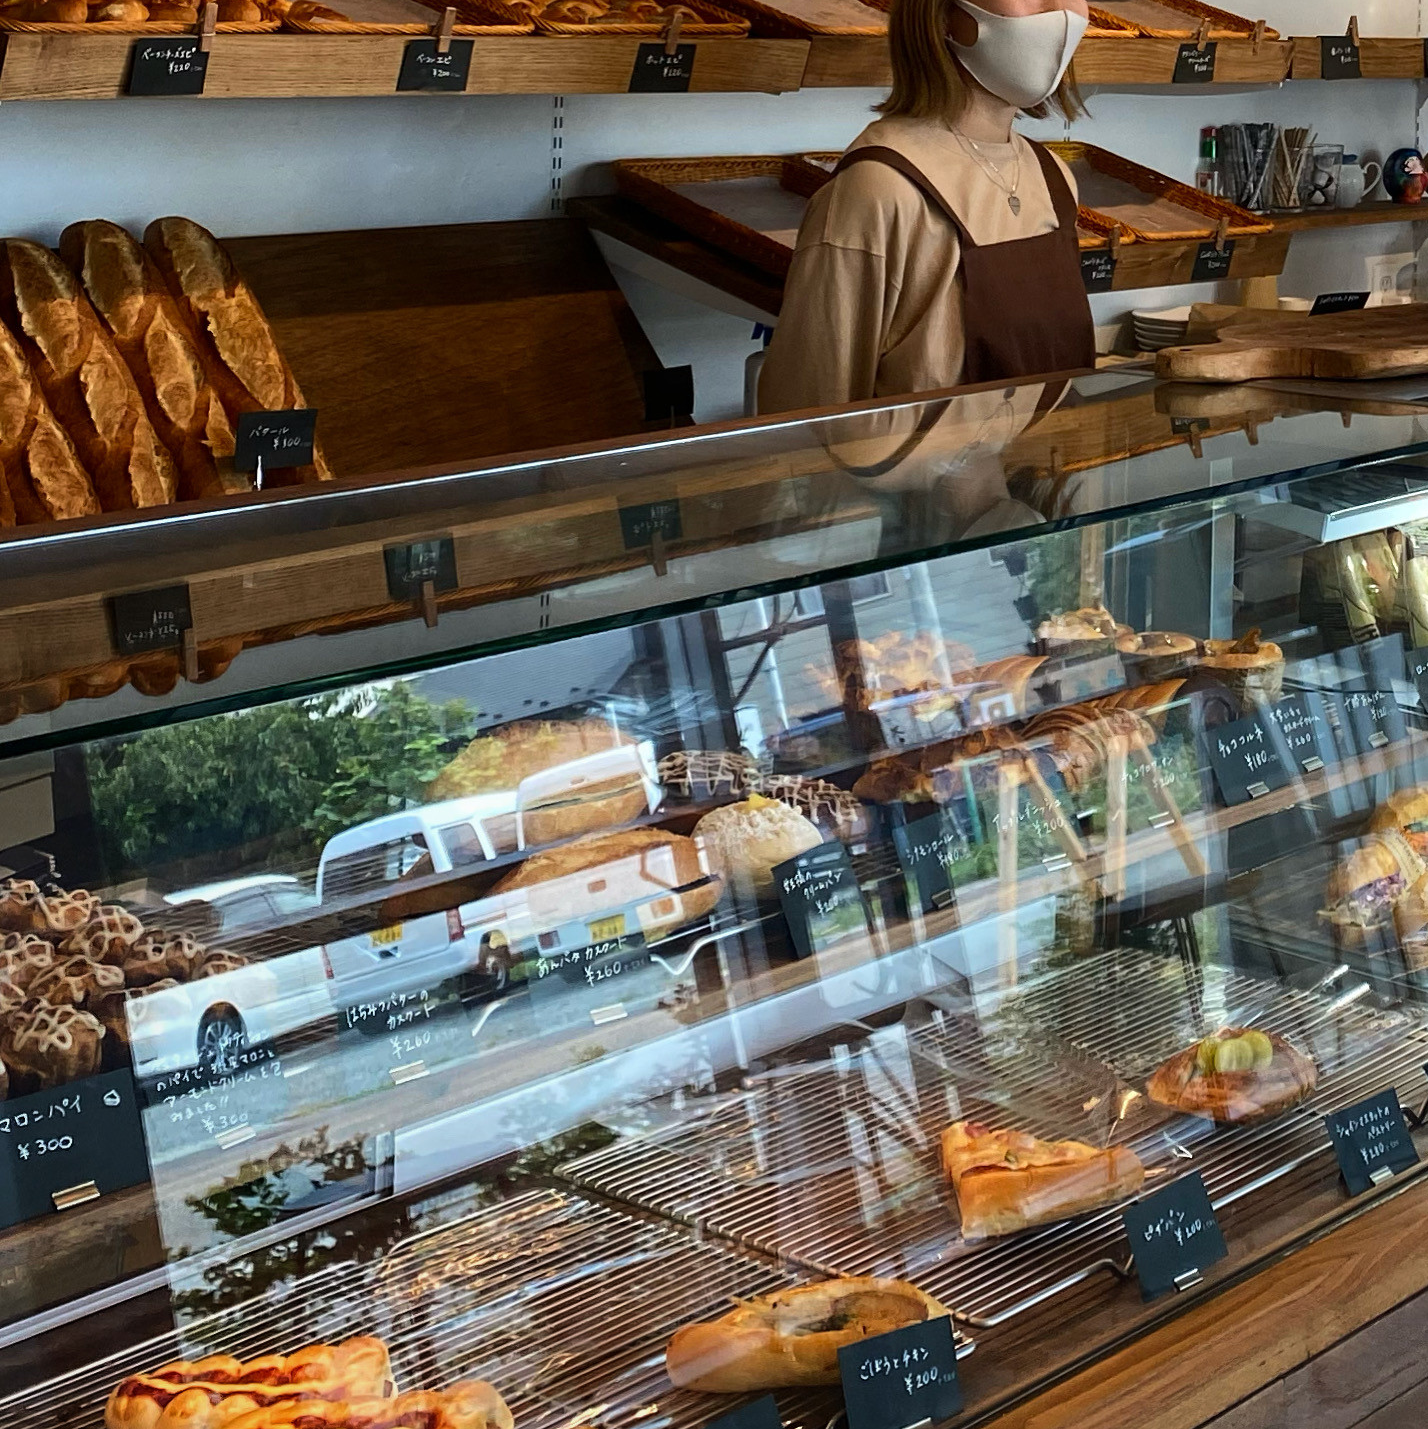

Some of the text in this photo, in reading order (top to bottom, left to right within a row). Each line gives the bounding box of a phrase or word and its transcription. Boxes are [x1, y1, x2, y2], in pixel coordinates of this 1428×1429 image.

[584, 961, 622, 987] ¥260
[390, 1030, 431, 1060] ¥260
[0, 1094, 82, 1133] マロンパイ
[17, 1135, 73, 1160] ¥300
[904, 1366, 938, 1396] ¥200
